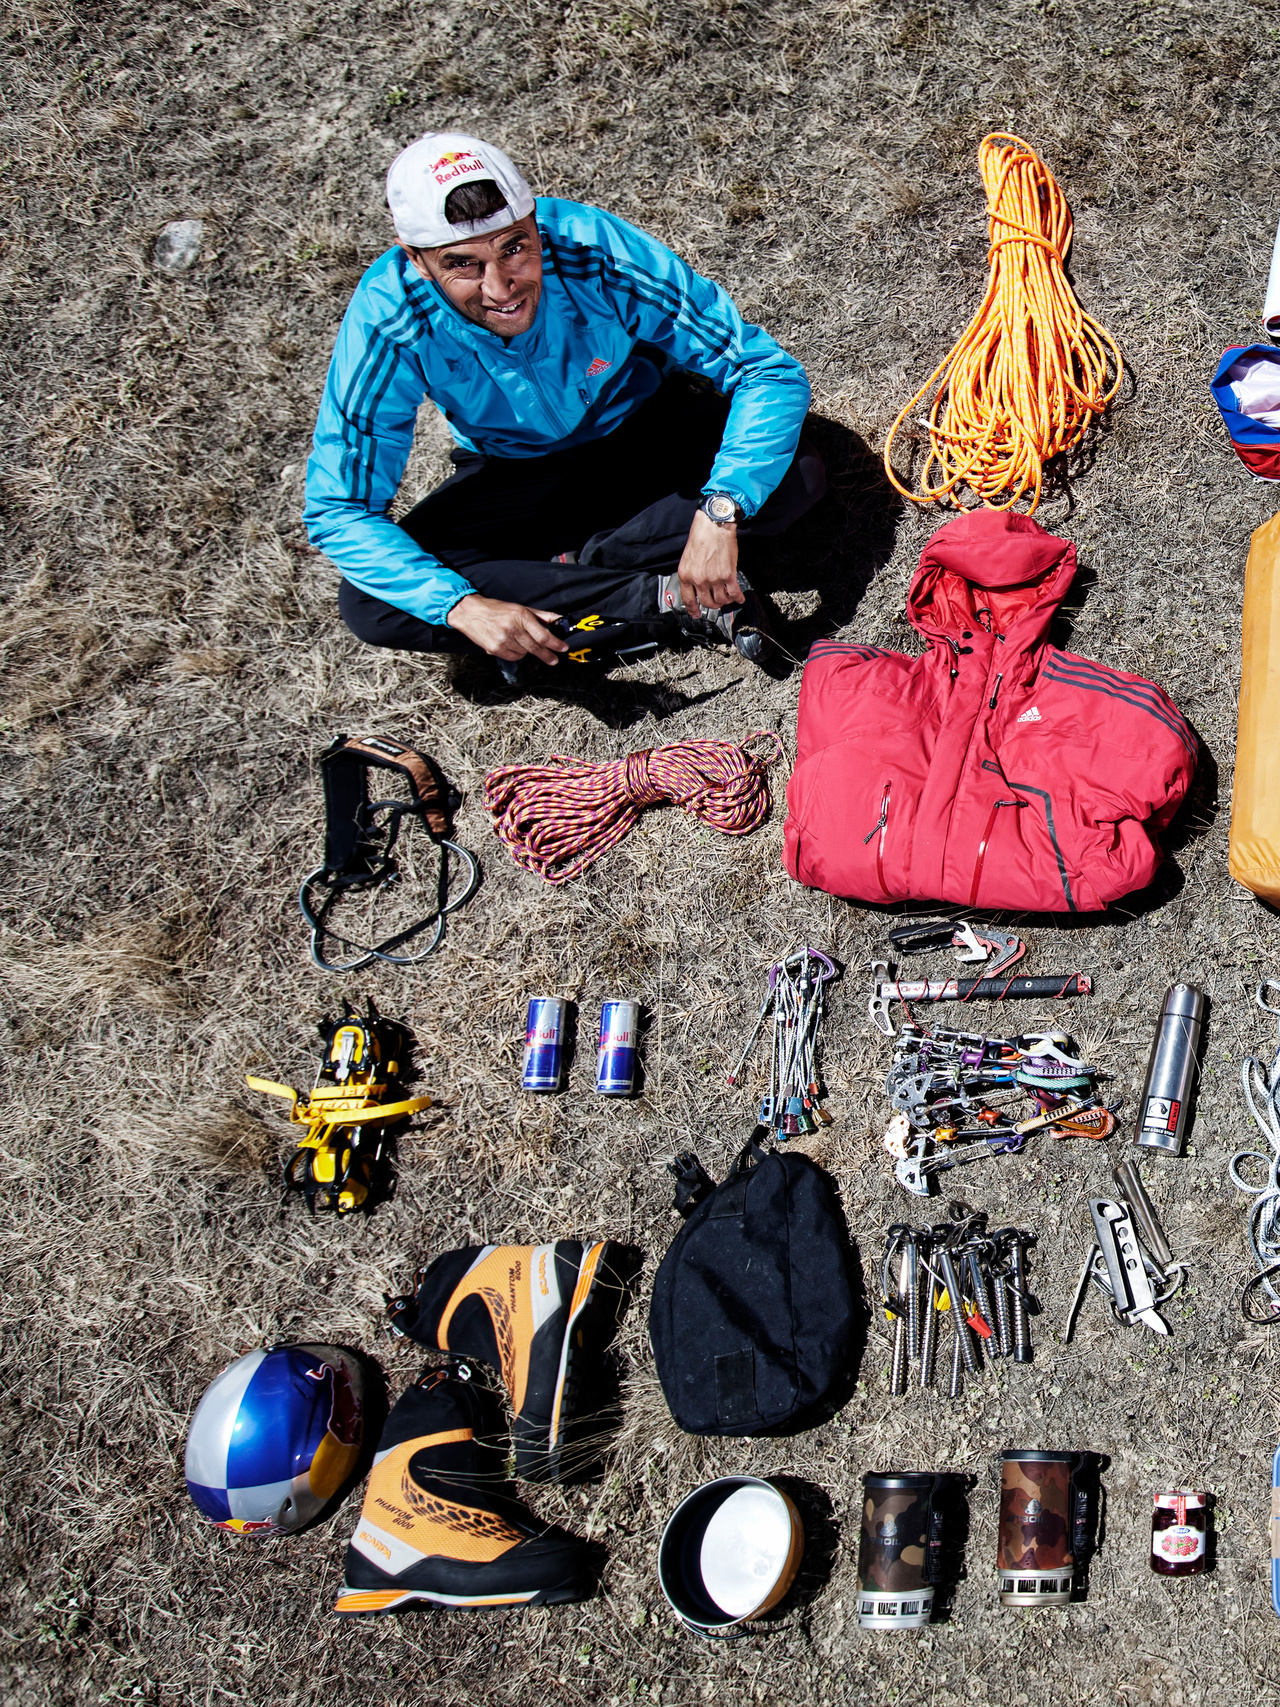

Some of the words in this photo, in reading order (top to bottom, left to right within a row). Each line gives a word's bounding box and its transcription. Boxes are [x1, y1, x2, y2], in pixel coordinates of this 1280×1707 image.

[435, 166, 460, 185] Red
[459, 159, 485, 174] Bull
[1017, 714, 1042, 723] adidas
[538, 1251, 549, 1296] SCARPA
[509, 1267, 517, 1313] PHANTOM
[375, 1497, 415, 1521] PHANTOM
[359, 1531, 392, 1560] SCARPA
